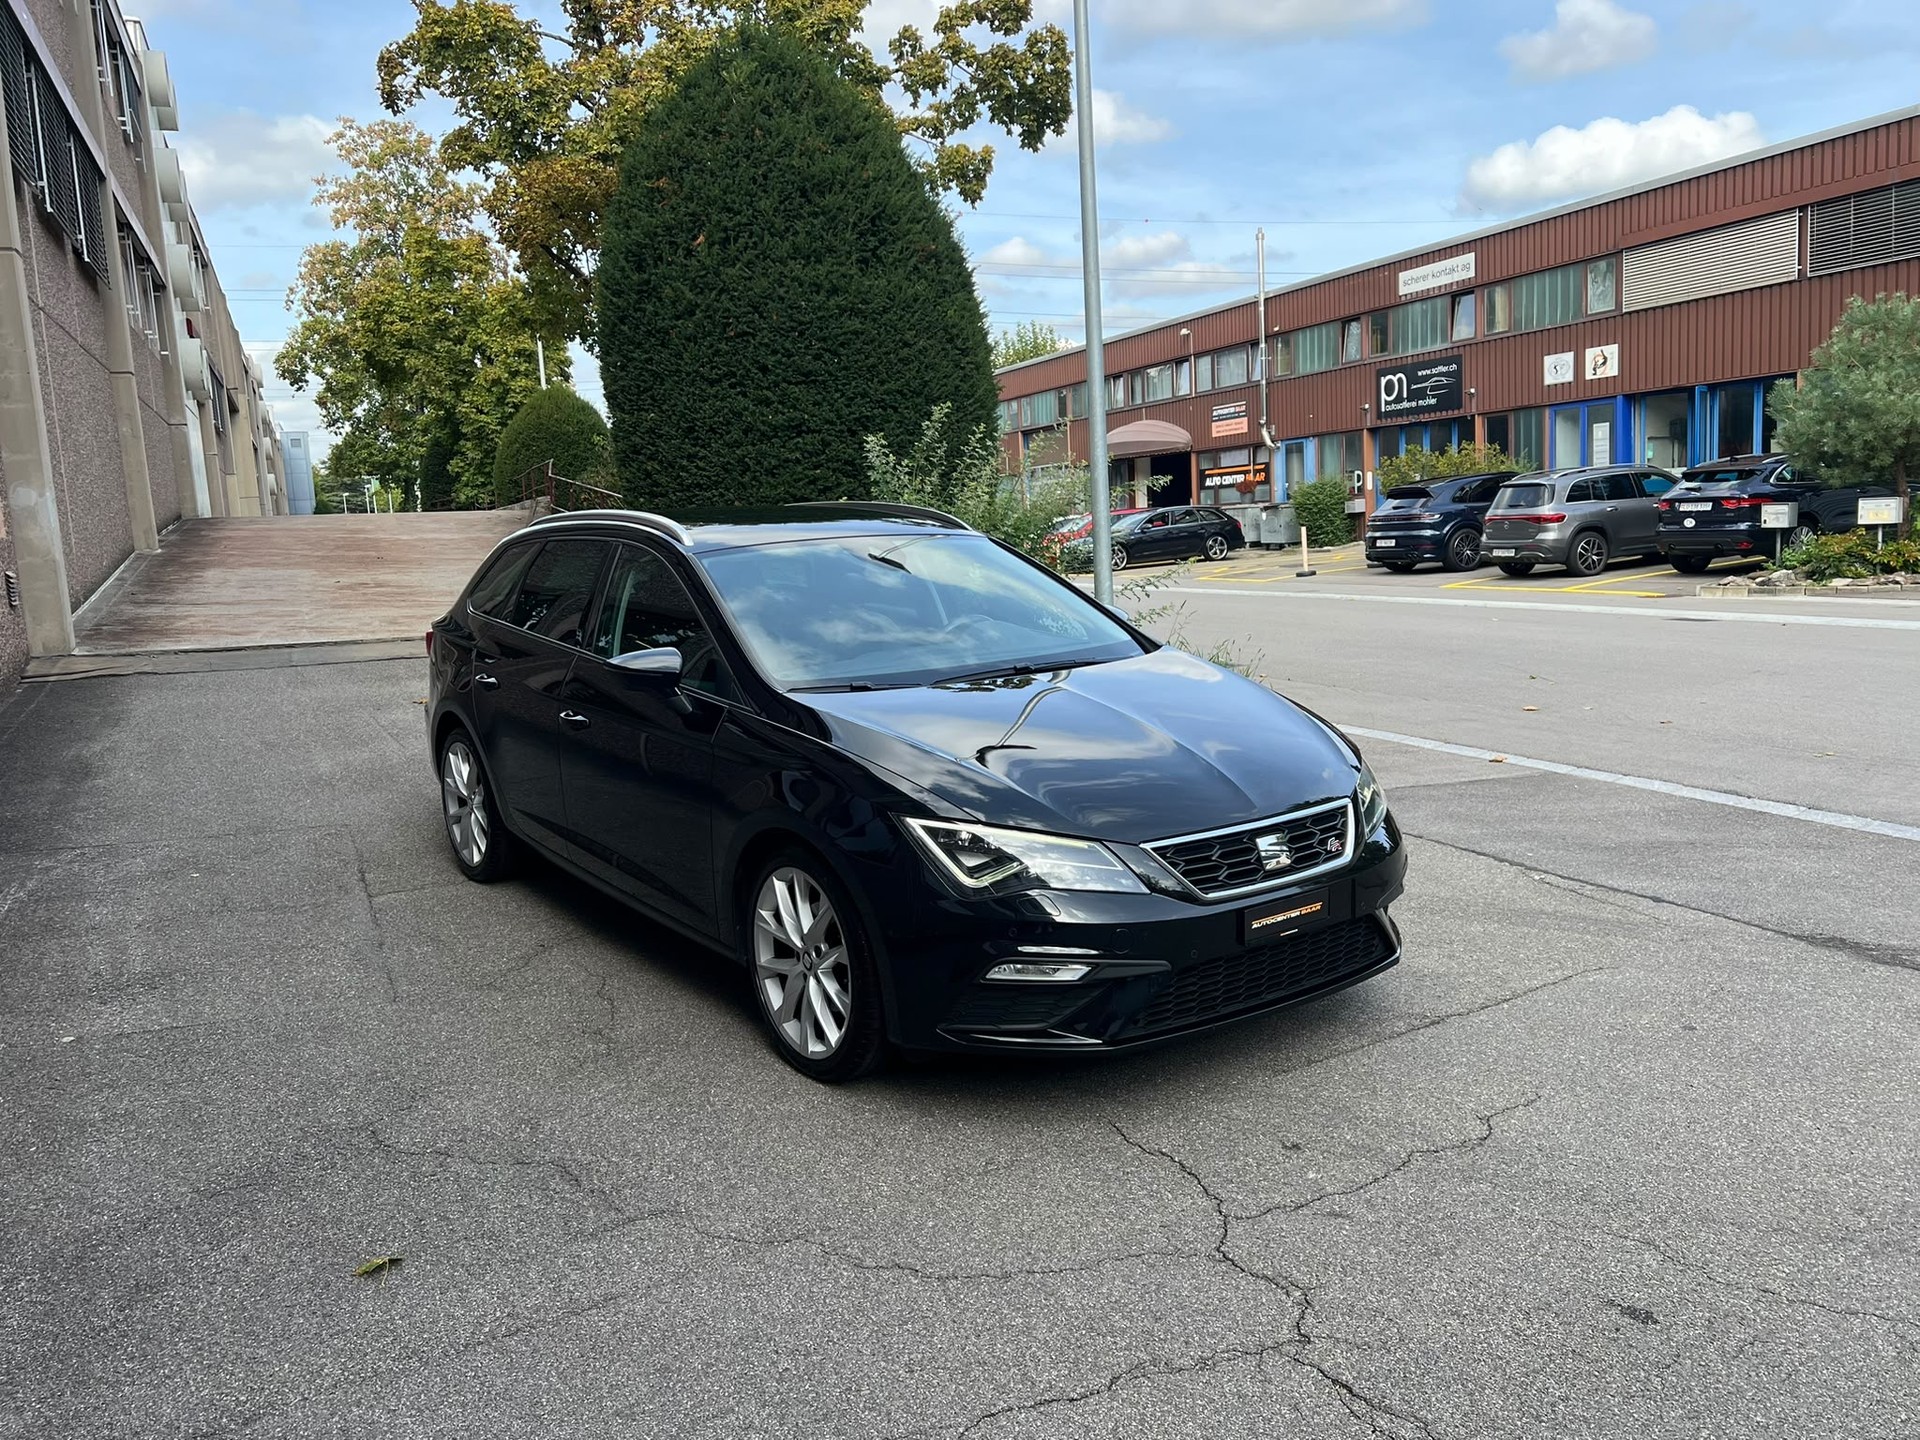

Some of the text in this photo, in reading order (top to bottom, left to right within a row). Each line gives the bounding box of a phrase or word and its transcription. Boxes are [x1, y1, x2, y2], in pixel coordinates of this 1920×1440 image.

[1402, 262, 1471, 287] scherer kontakt ag
[1418, 396, 1437, 406] mohler
[1222, 474, 1245, 485] CENTER
[1251, 905, 1322, 929] AUTOCENTER BAAR
